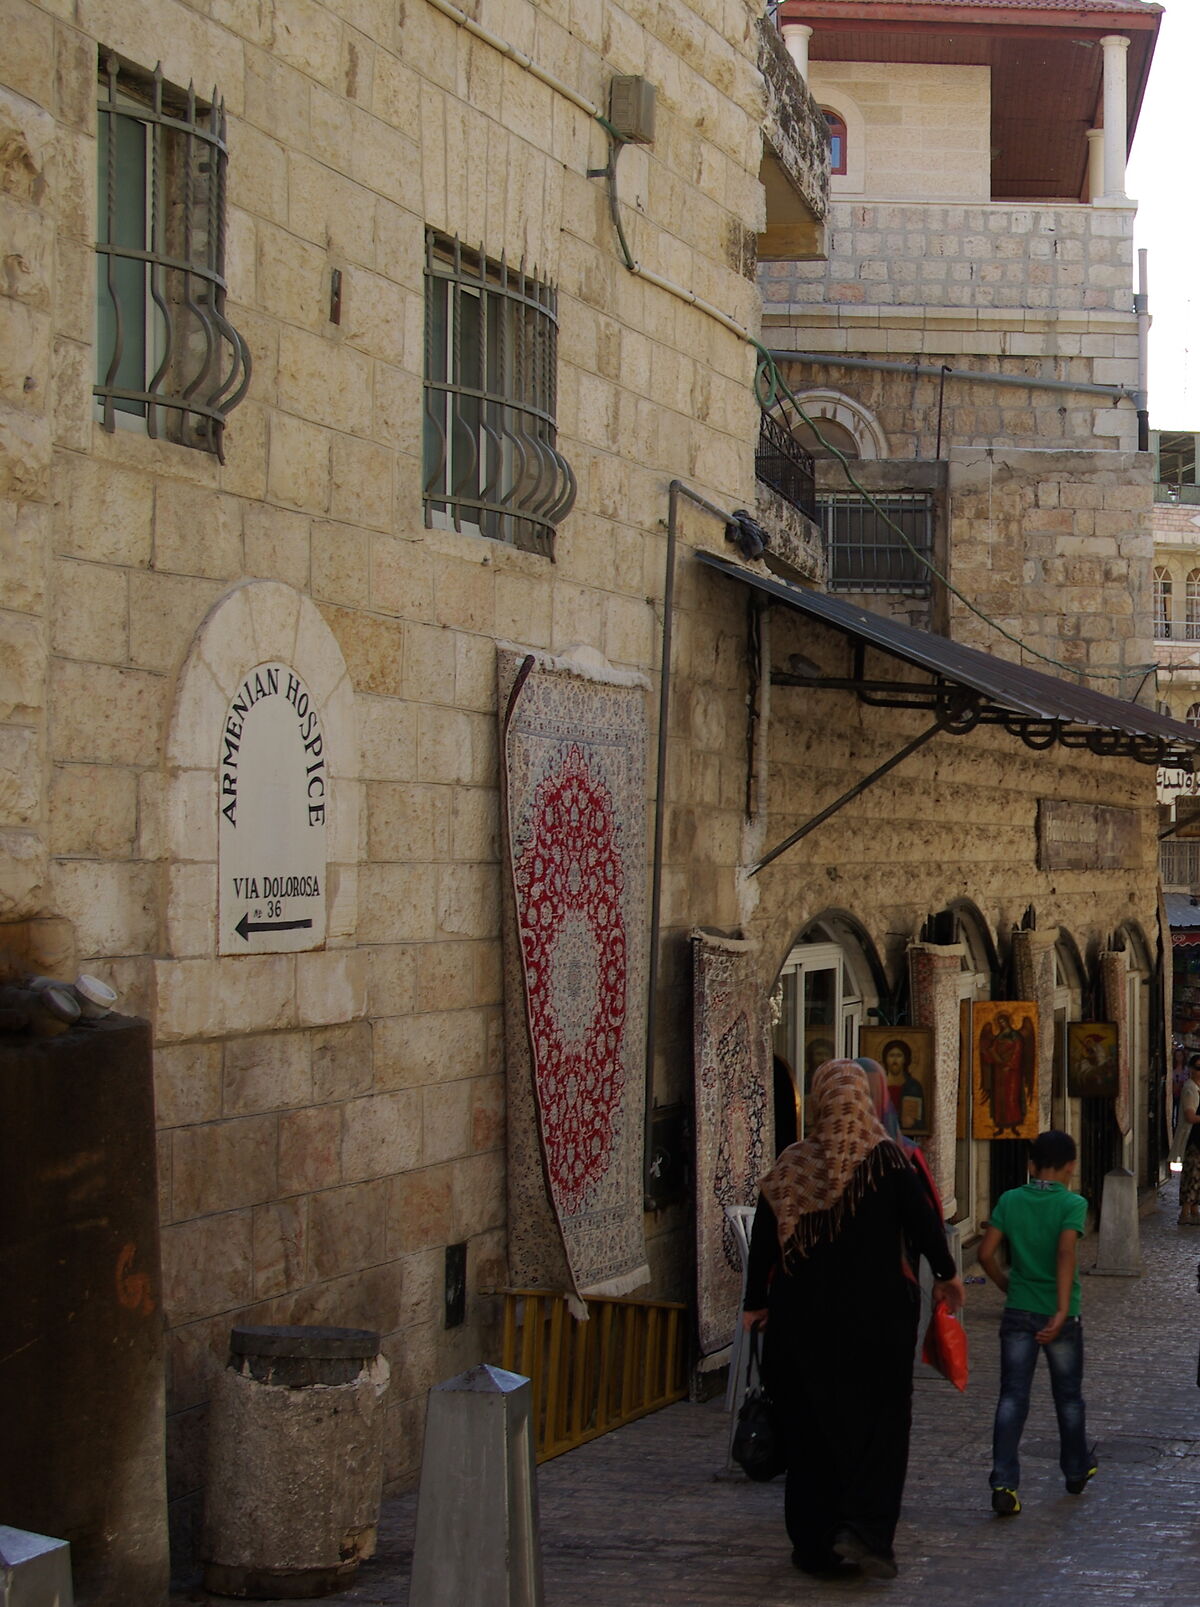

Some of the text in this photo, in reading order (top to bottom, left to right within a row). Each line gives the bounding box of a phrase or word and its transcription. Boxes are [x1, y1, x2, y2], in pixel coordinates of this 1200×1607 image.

[222, 669, 325, 828] ARMENIAN HOSPICE
[232, 875, 320, 899] VIA DOLOROSA
[267, 900, 282, 918] 36
